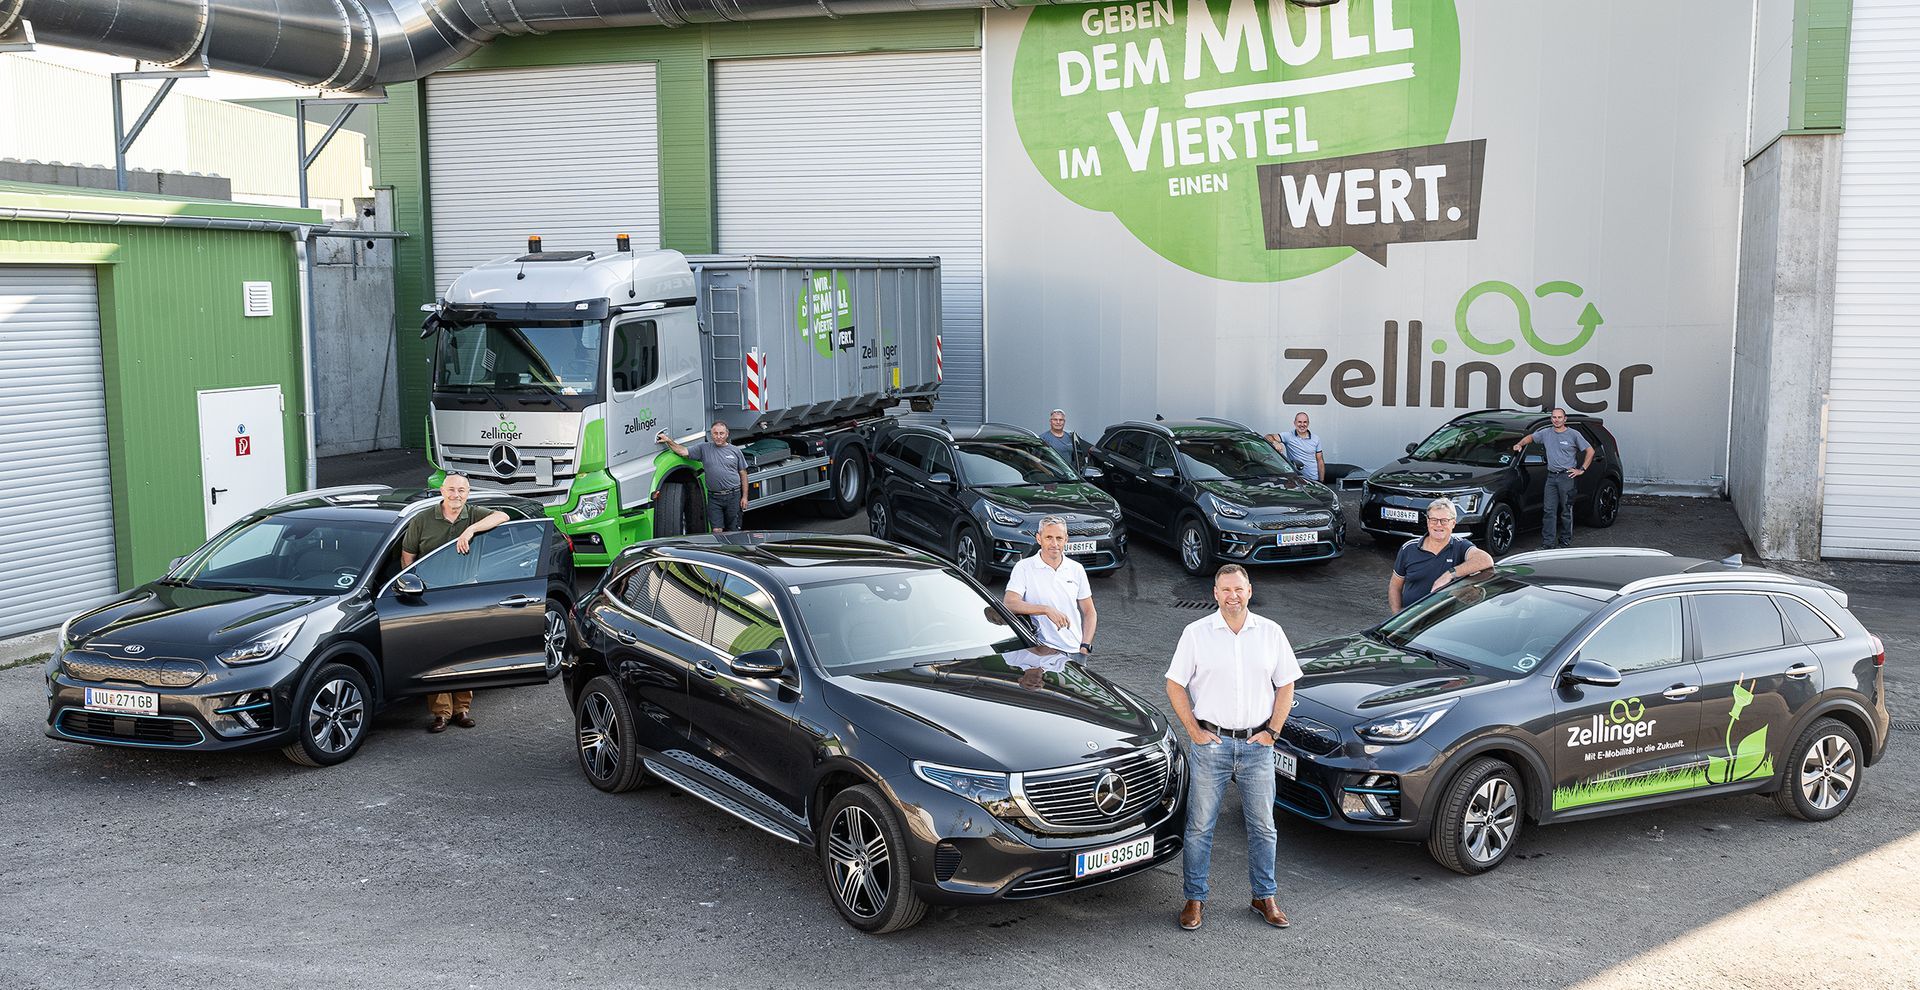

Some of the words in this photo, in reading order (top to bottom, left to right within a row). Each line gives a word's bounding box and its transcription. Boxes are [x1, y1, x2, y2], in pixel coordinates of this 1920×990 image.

[1082, 0, 1175, 37] GEBEN
[1058, 38, 1171, 97] DEM
[1058, 146, 1102, 180] IM
[1107, 106, 1319, 172] VIERTEL
[1169, 173, 1229, 197] EINEN
[1281, 164, 1463, 228] WERT.
[802, 303, 820, 317] DM
[813, 318, 833, 334] VIERTE
[95, 691, 108, 705] UU
[1584, 752, 1596, 761] Mit
[1597, 747, 1635, 759] E-Mobilität
[1636, 745, 1643, 753] in
[1644, 743, 1655, 752] die
[1087, 852, 1103, 870] UU
